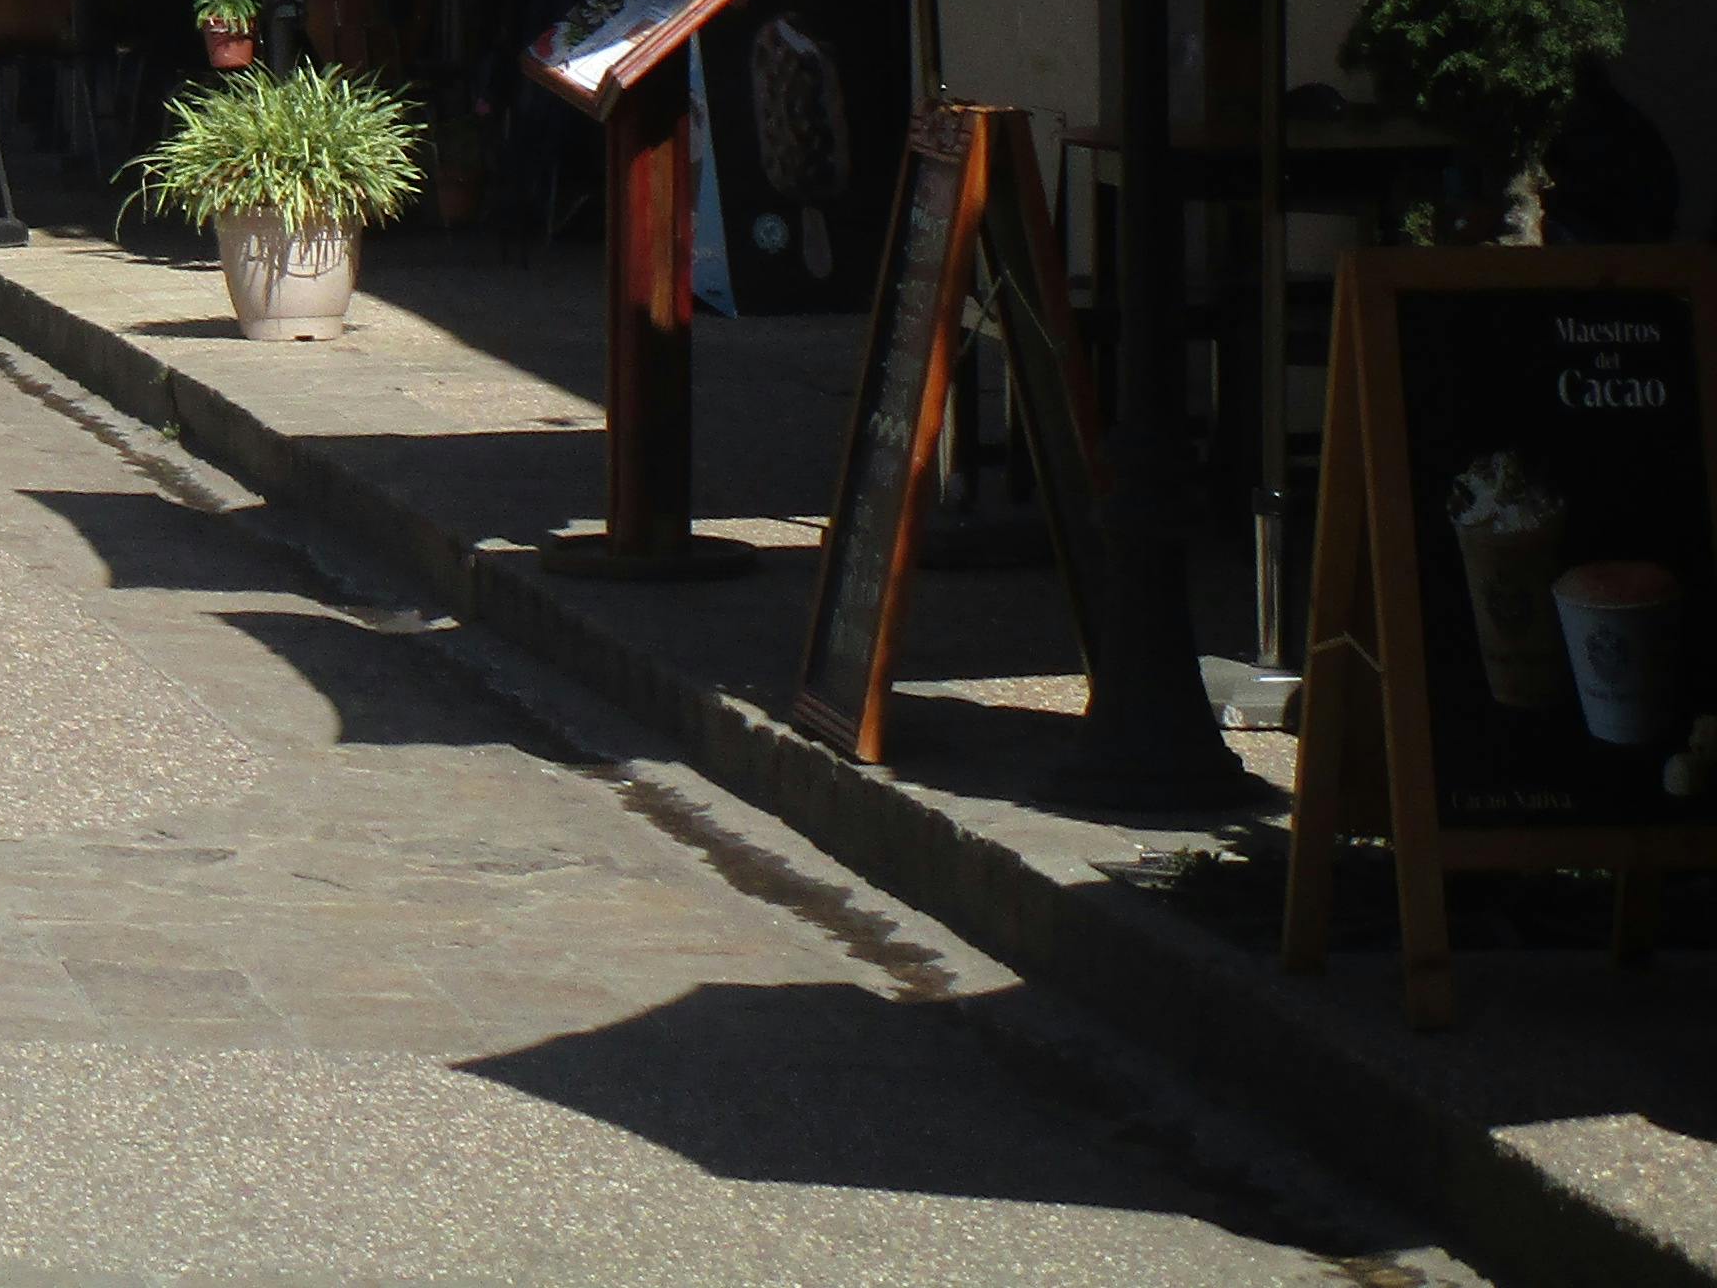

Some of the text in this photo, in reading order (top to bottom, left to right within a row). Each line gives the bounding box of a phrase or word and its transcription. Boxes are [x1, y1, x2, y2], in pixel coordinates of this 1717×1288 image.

[1556, 317, 1662, 343] Maestros
[1594, 351, 1621, 369] del
[1557, 368, 1667, 409] Cacao
